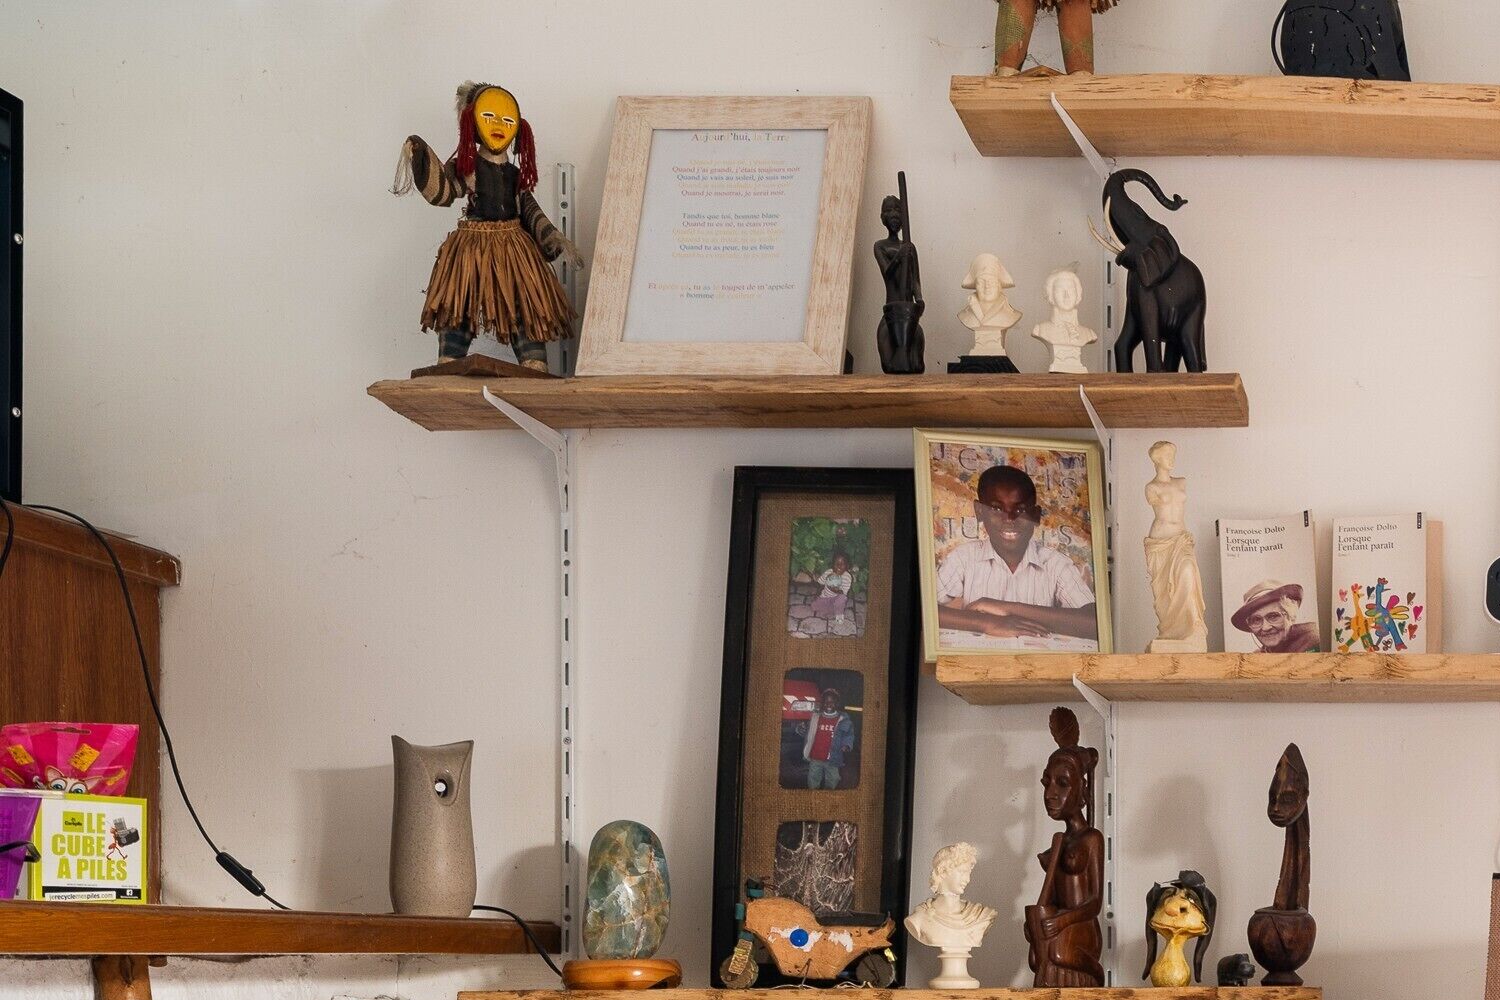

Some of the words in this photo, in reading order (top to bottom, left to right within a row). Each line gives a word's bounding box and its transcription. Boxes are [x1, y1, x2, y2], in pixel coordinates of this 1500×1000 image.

[1226, 527, 1262, 535] Françoise
[1264, 526, 1285, 534] Dolto
[1226, 536, 1260, 545] Lorsque
[1338, 535, 1371, 544] Lorsque
[1226, 544, 1257, 552] l'enfant
[1338, 543, 1368, 551] l'enfant
[87, 813, 105, 834] LE
[52, 834, 105, 856] CUBE
[77, 859, 128, 881] PILES
